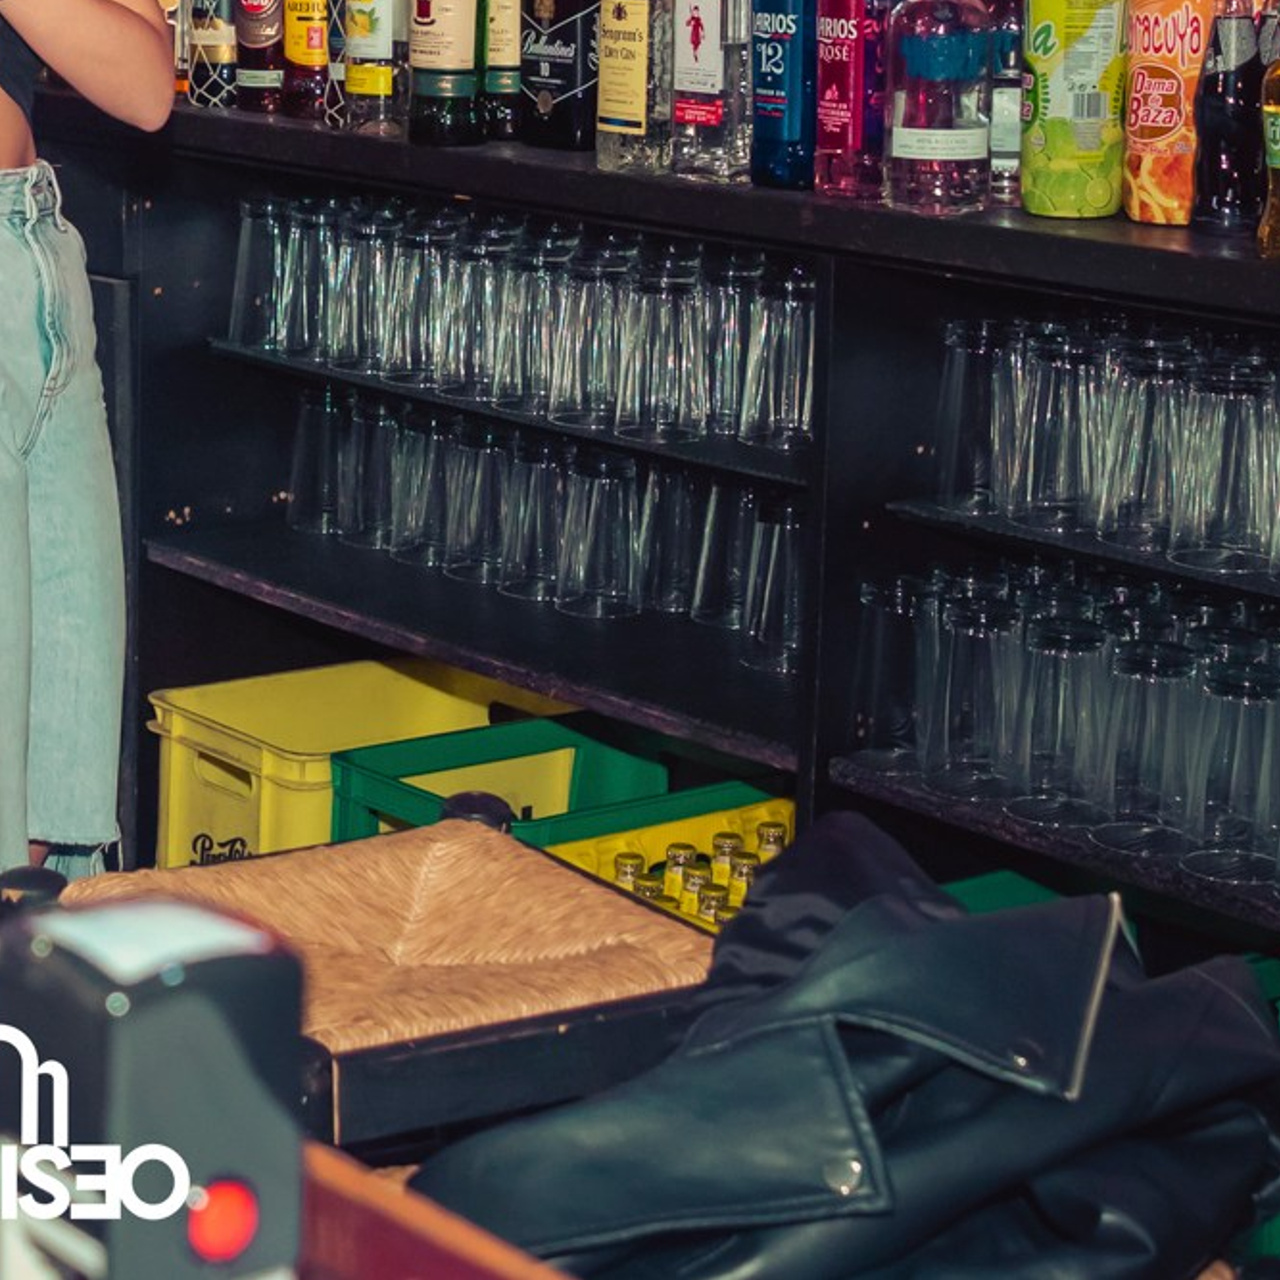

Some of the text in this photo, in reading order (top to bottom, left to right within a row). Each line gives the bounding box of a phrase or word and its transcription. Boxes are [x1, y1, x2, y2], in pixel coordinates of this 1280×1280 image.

[756, 41, 785, 75] 12
[1133, 70, 1178, 96] Dama
[1128, 96, 1179, 129] Baza
